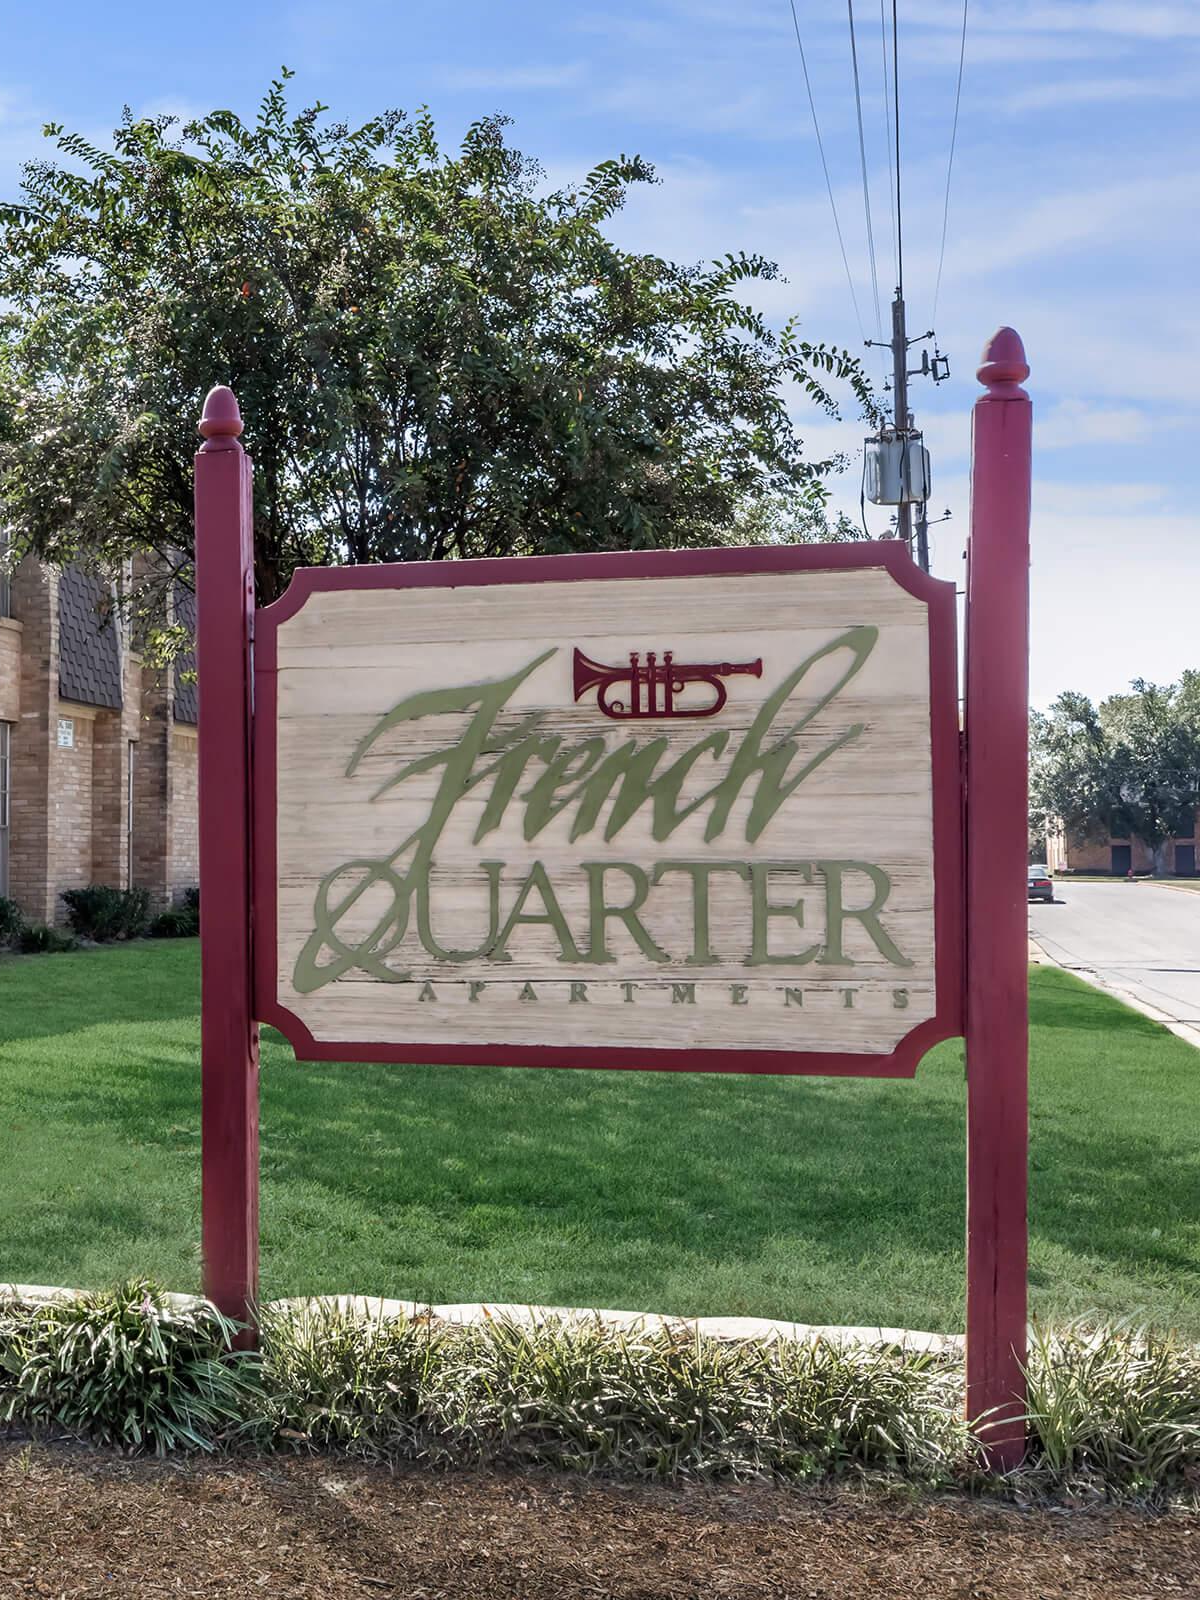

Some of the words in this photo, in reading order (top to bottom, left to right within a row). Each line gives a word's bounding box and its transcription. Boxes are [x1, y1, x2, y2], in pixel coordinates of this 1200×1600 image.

[293, 625, 879, 993] French
[313, 861, 916, 983] QUARTER
[418, 983, 910, 1010] APARTMENTS
